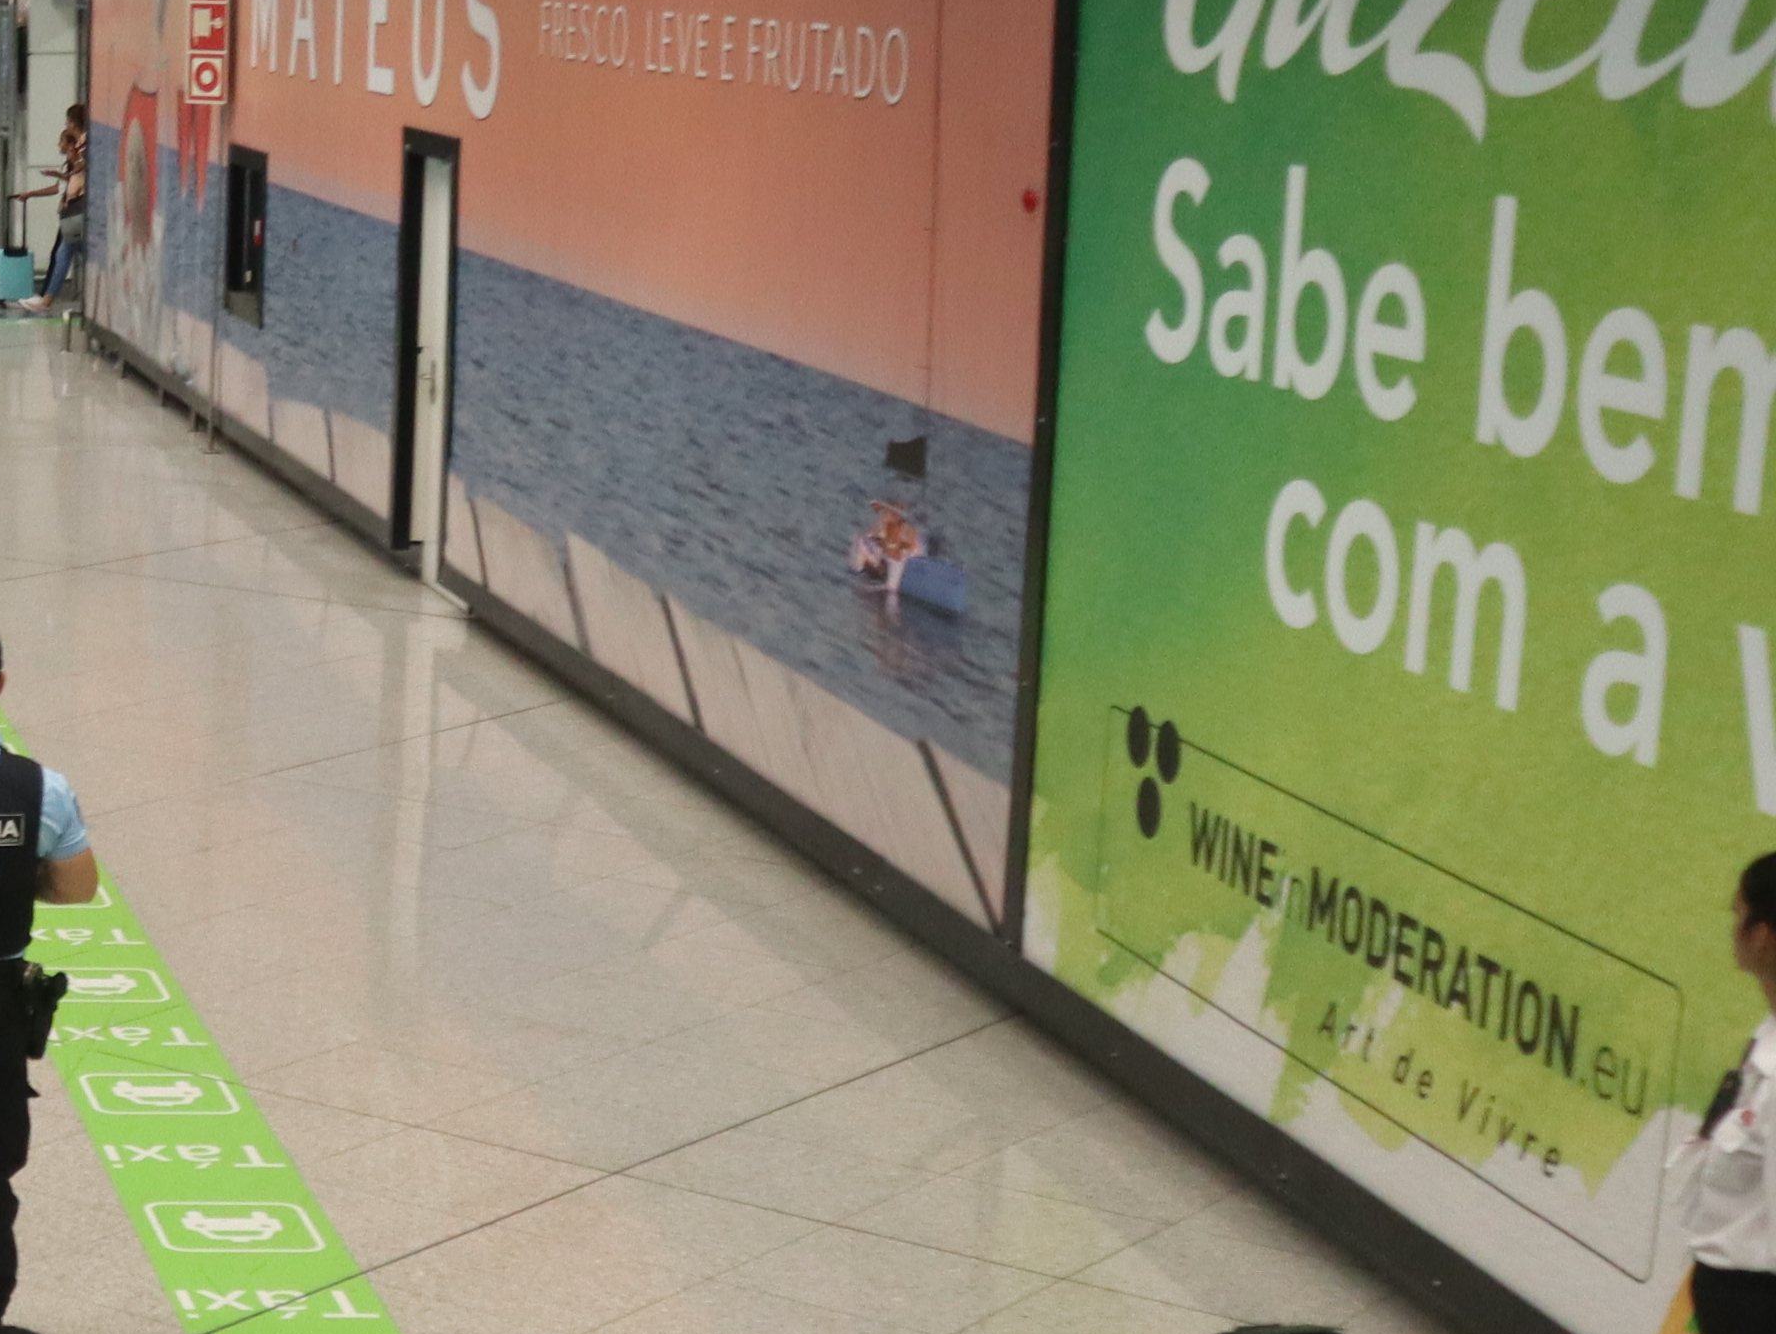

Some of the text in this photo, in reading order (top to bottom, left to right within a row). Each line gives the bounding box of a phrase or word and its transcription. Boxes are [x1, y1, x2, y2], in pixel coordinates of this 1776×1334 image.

[538, 0, 635, 78] FRESCO,
[646, 10, 710, 79] LEVE
[719, 15, 737, 82] E
[745, 17, 910, 106] FRUTADO
[1145, 157, 1427, 422] Sabe
[1264, 478, 1527, 712] com
[1580, 582, 1668, 768] a
[29, 927, 146, 946] Táx
[48, 1025, 209, 1048] Táxi
[1317, 1003, 1561, 1178] Art de Vivre
[102, 1143, 286, 1169] Táxi
[173, 1288, 381, 1320] Táxi
